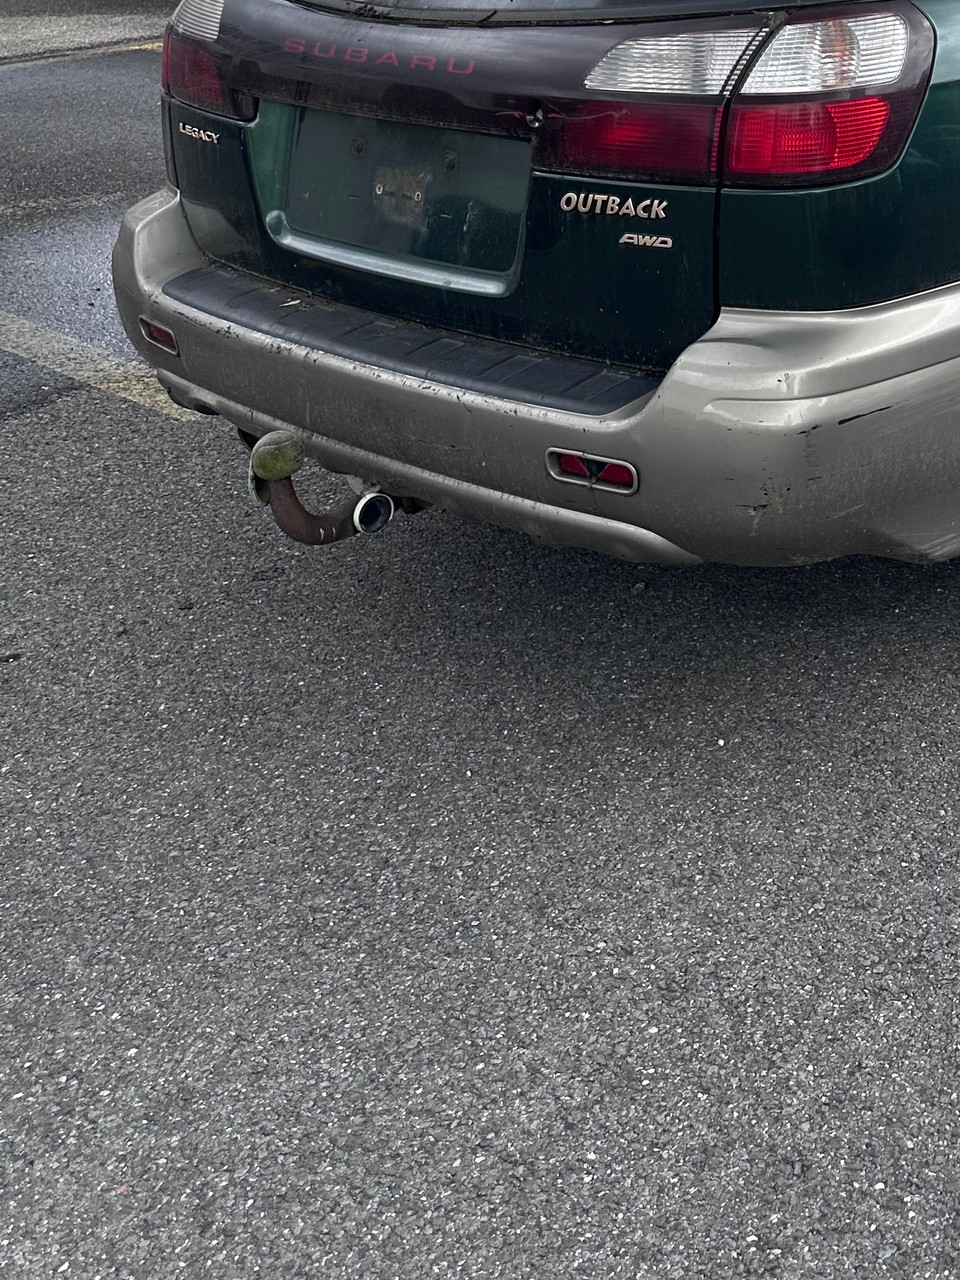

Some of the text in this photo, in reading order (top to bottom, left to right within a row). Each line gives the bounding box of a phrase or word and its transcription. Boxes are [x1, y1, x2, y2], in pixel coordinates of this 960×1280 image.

[284, 37, 476, 74] SUBARU
[179, 122, 220, 144] LEGACY
[560, 192, 668, 219] OUTBACK
[619, 234, 673, 248] AWD
